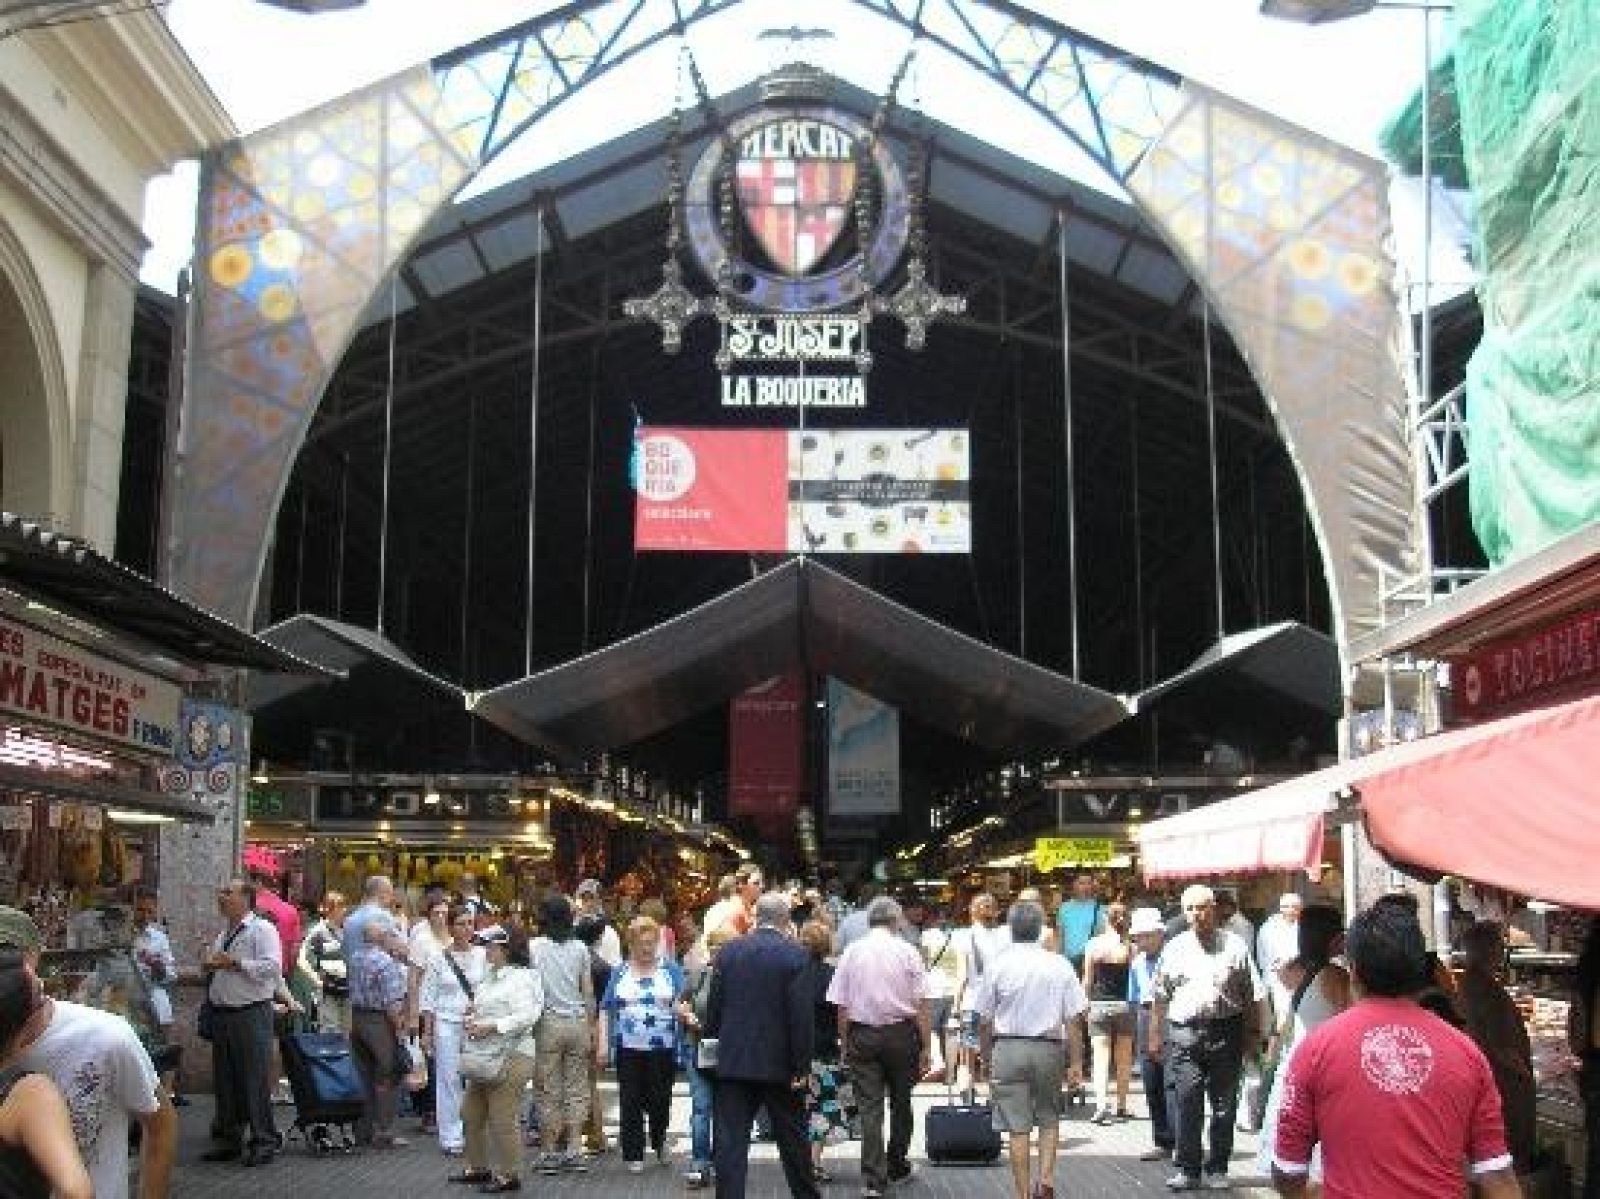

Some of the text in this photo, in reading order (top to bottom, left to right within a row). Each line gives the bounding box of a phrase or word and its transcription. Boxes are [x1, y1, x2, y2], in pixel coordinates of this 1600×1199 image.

[741, 121, 853, 160] MERCAT
[760, 318, 860, 357] JOSEP
[720, 374, 867, 406] LA BOQUERIA
[0, 659, 129, 736] MATGES
